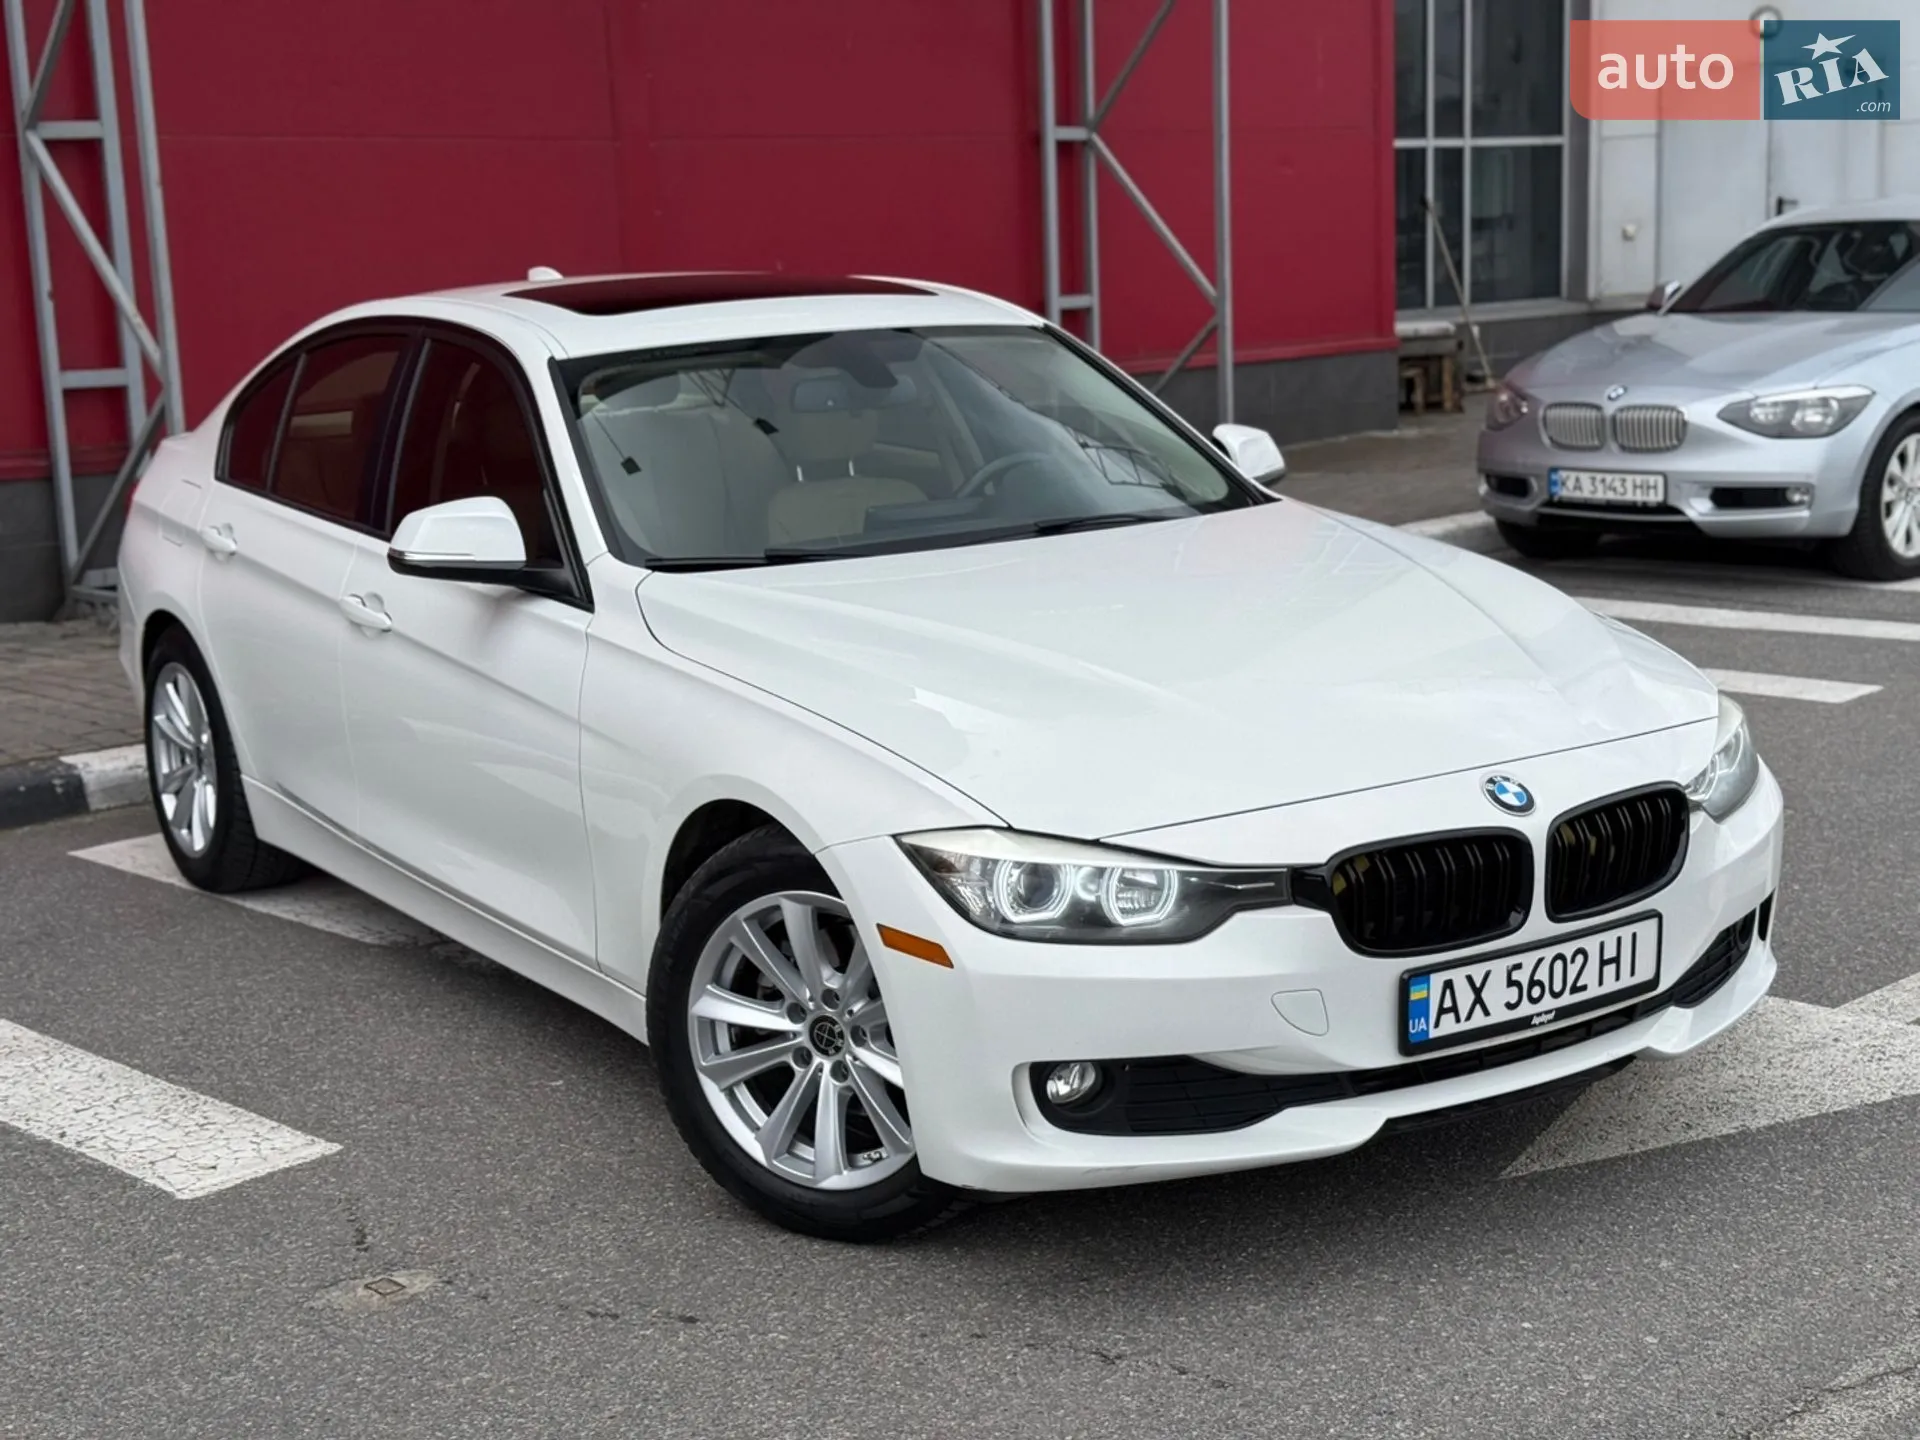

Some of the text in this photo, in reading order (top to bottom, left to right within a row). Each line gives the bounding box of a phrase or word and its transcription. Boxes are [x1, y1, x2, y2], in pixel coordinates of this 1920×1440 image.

[1561, 474, 1658, 498] KA 3143 HH
[1433, 932, 1638, 1029] AX 5602 HI
[1409, 1016, 1428, 1034] UA
